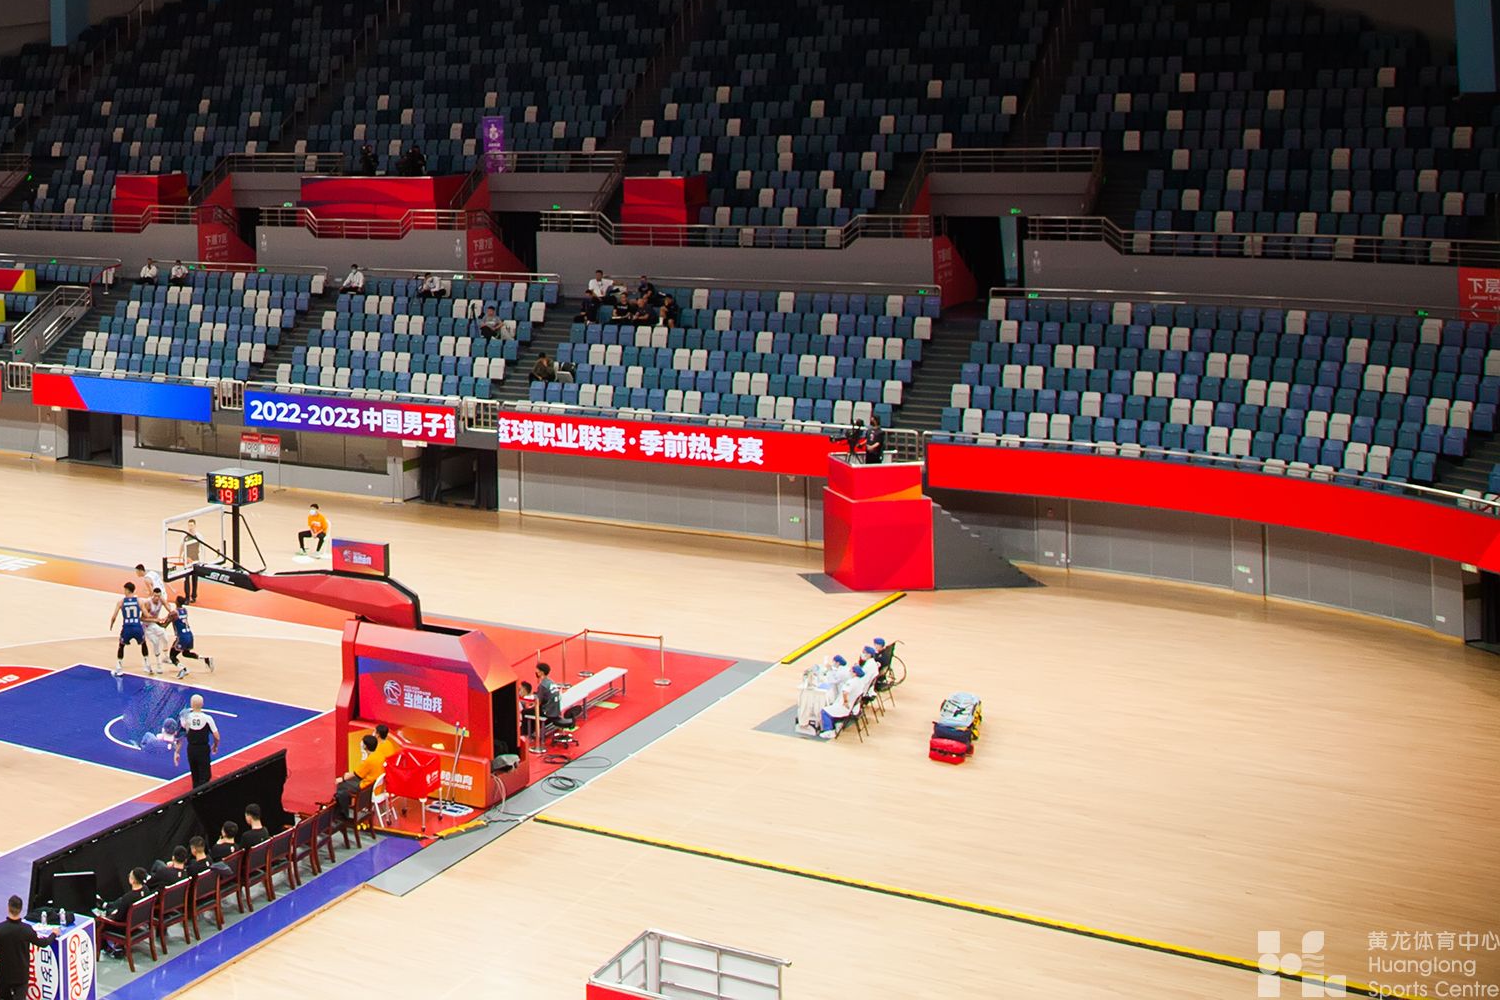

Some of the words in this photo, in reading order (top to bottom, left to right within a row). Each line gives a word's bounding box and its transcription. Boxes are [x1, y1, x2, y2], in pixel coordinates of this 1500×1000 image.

[218, 488, 234, 504] 19
[248, 486, 259, 502] 19
[125, 606, 138, 618] 17
